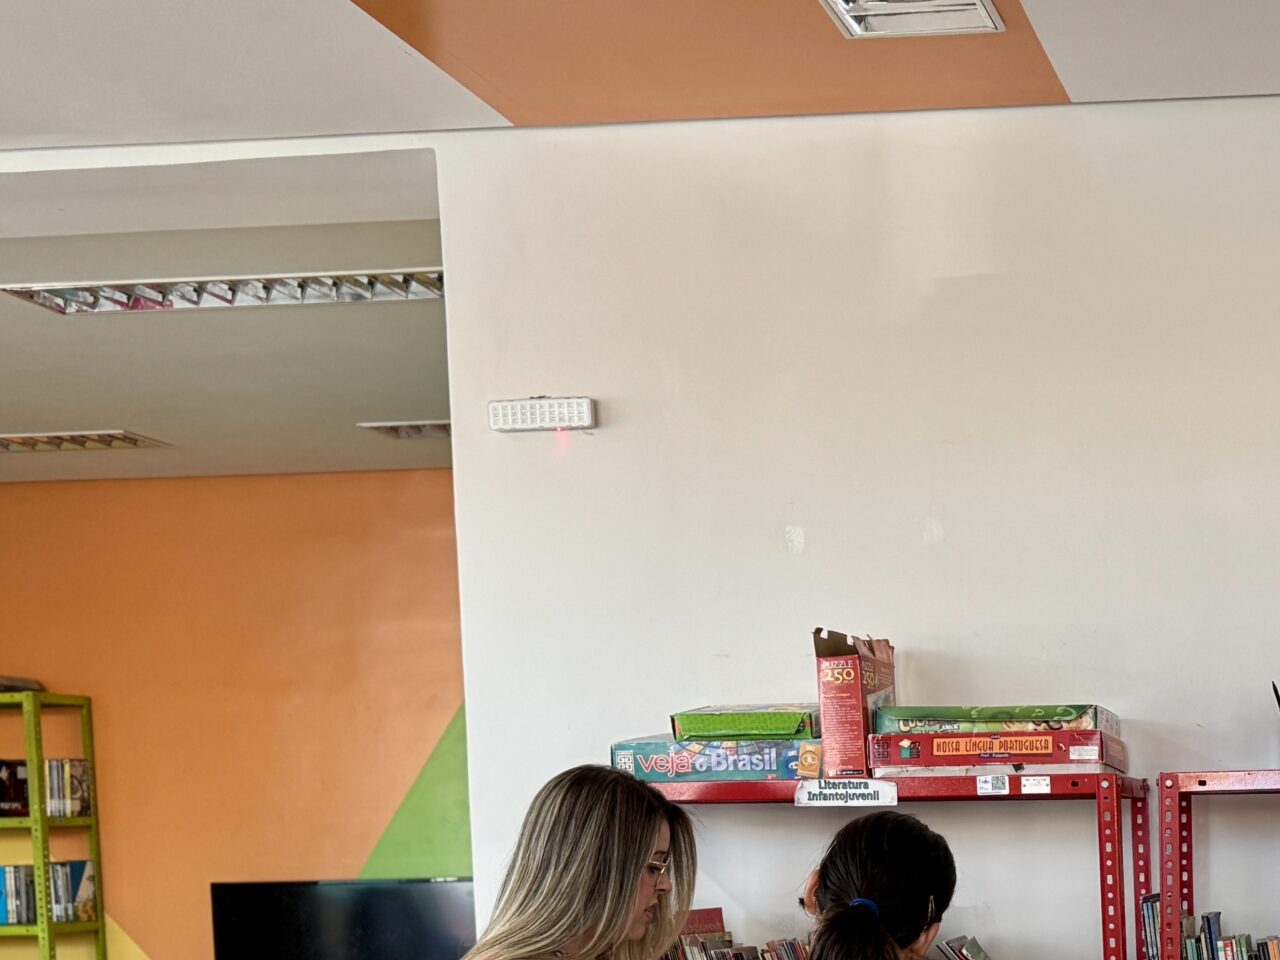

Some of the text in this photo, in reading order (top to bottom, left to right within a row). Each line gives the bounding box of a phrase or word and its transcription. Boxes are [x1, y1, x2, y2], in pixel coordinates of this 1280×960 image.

[823, 668, 855, 684] 250
[936, 738, 1049, 753] NOSSA LÍNGUA PORTUGUESA
[637, 749, 692, 777] veja
[711, 748, 778, 772] Brasil
[818, 780, 870, 790] Literatura
[807, 790, 880, 803] Infantojuvenil
